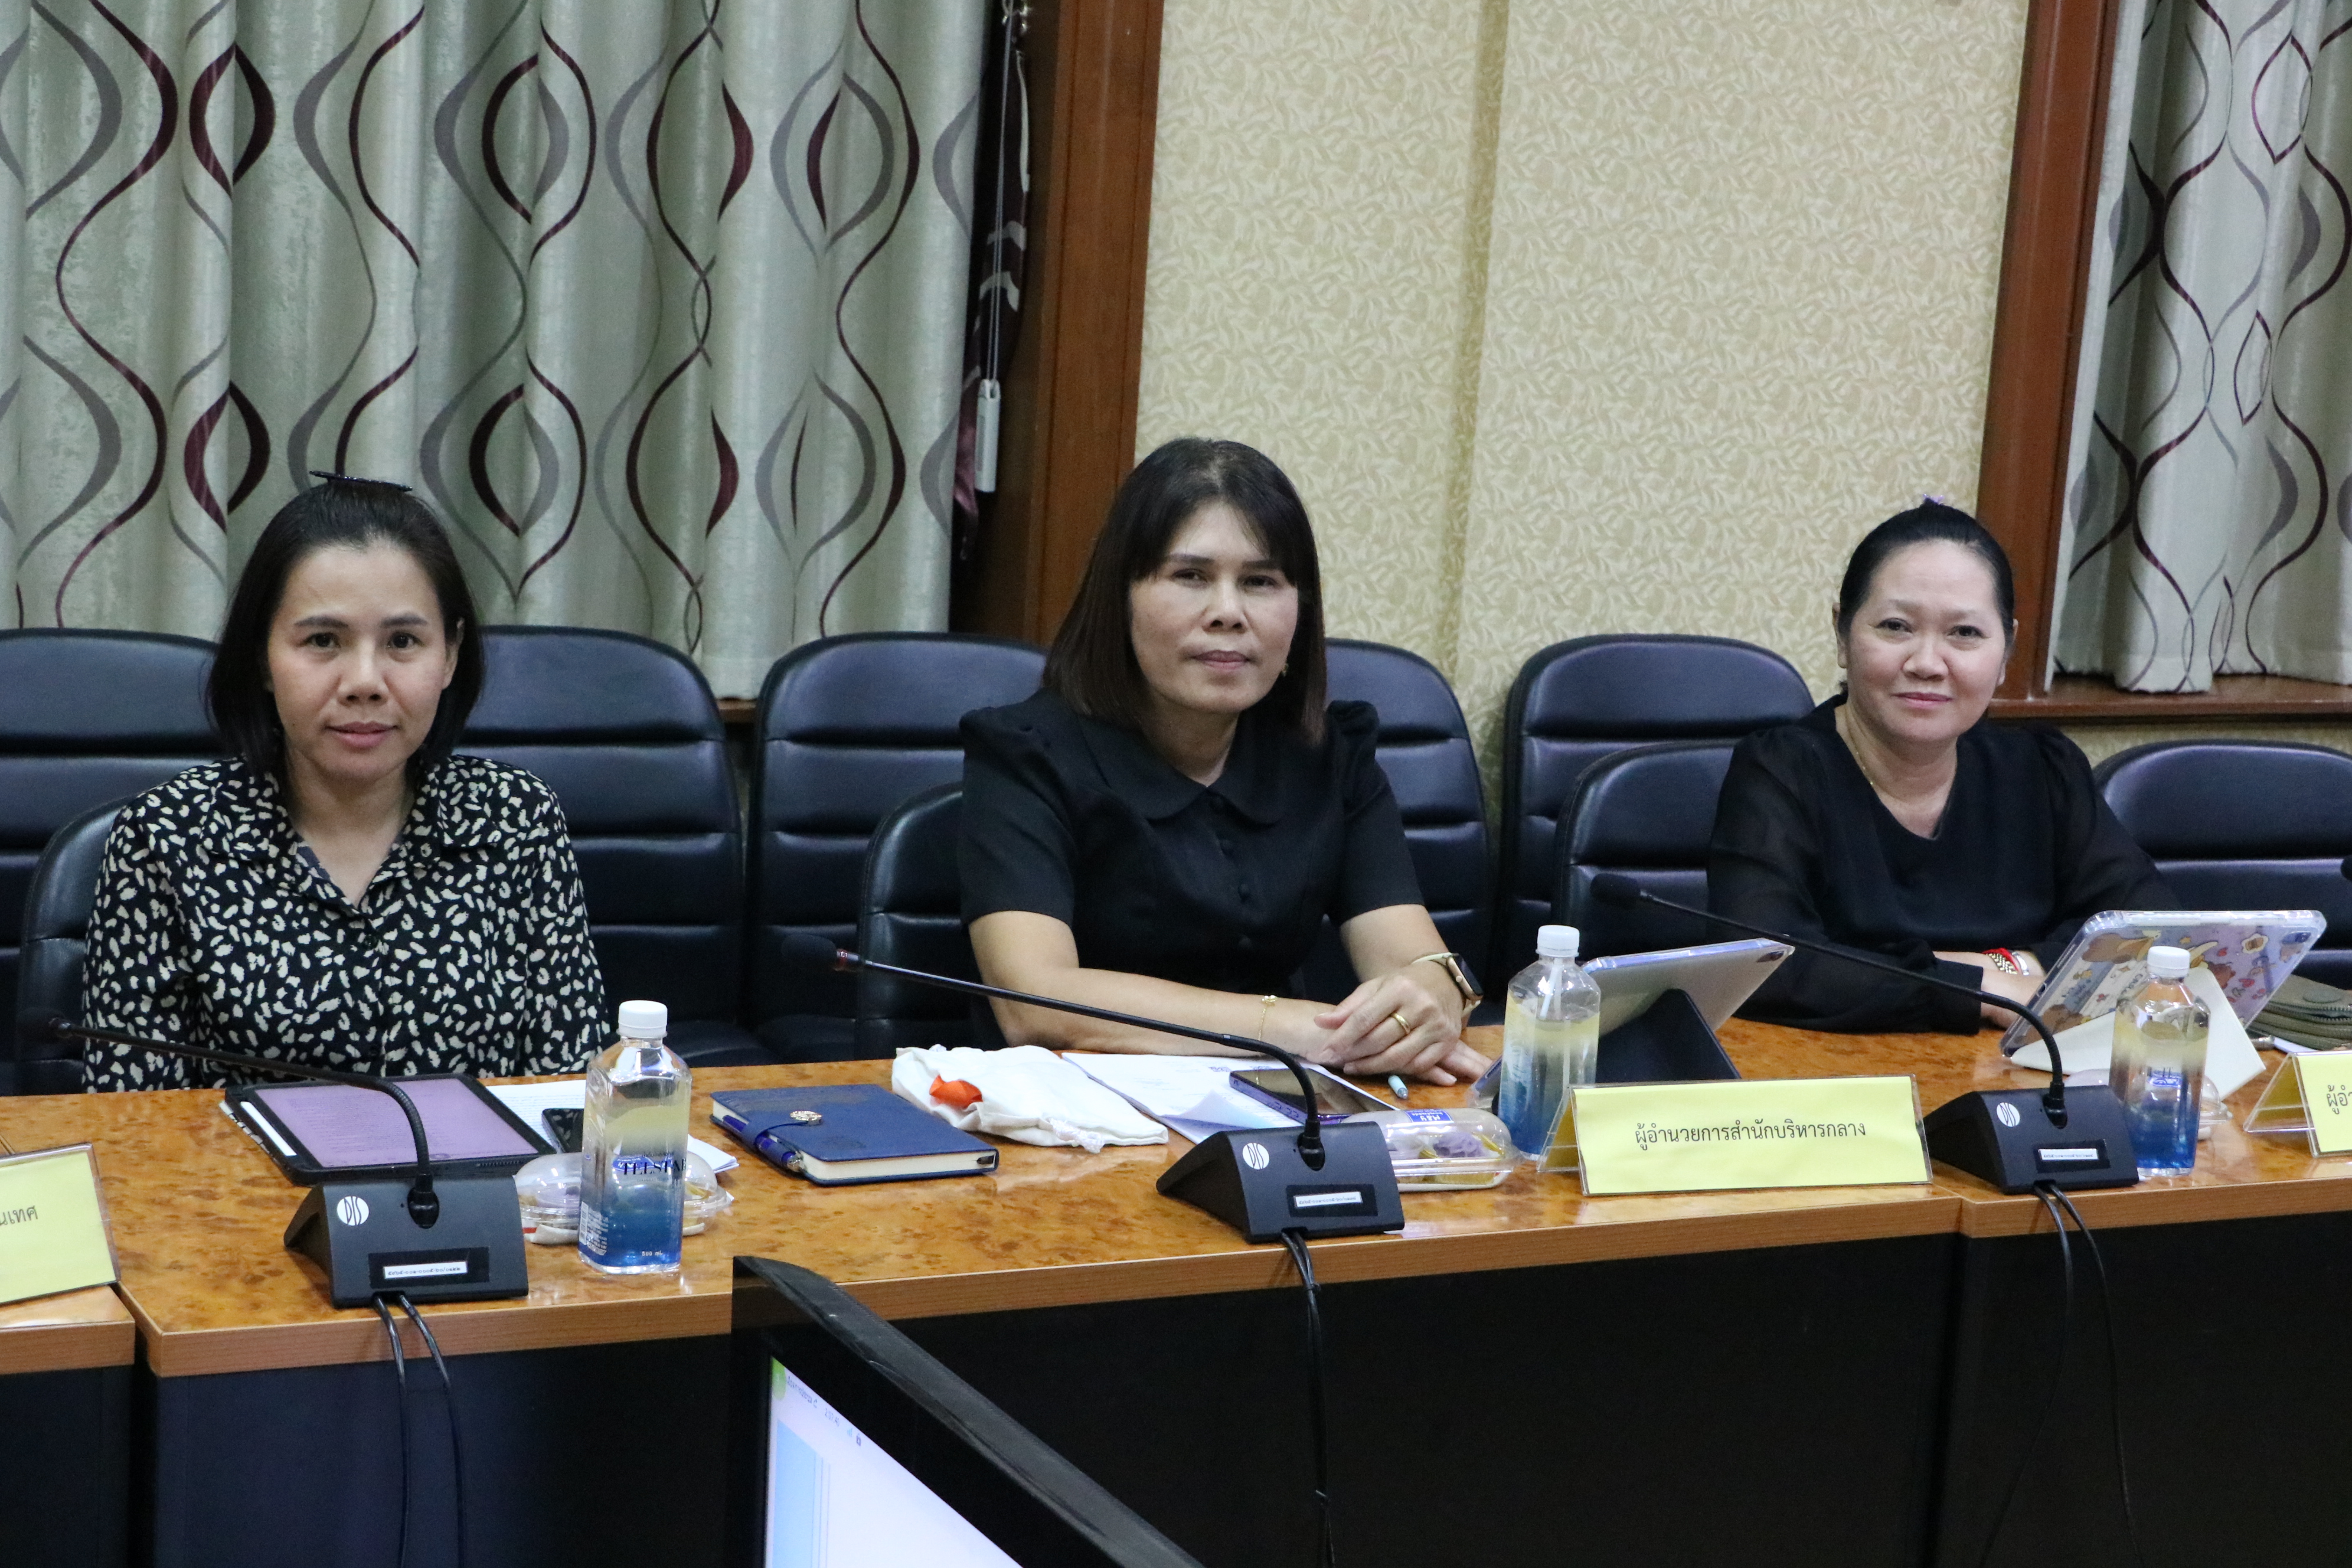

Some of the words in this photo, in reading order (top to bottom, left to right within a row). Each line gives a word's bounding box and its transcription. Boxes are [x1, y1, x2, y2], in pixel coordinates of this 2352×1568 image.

[1635, 1118, 1866, 1151] ผู้อำนวยการสำนักบริหารกลาง
